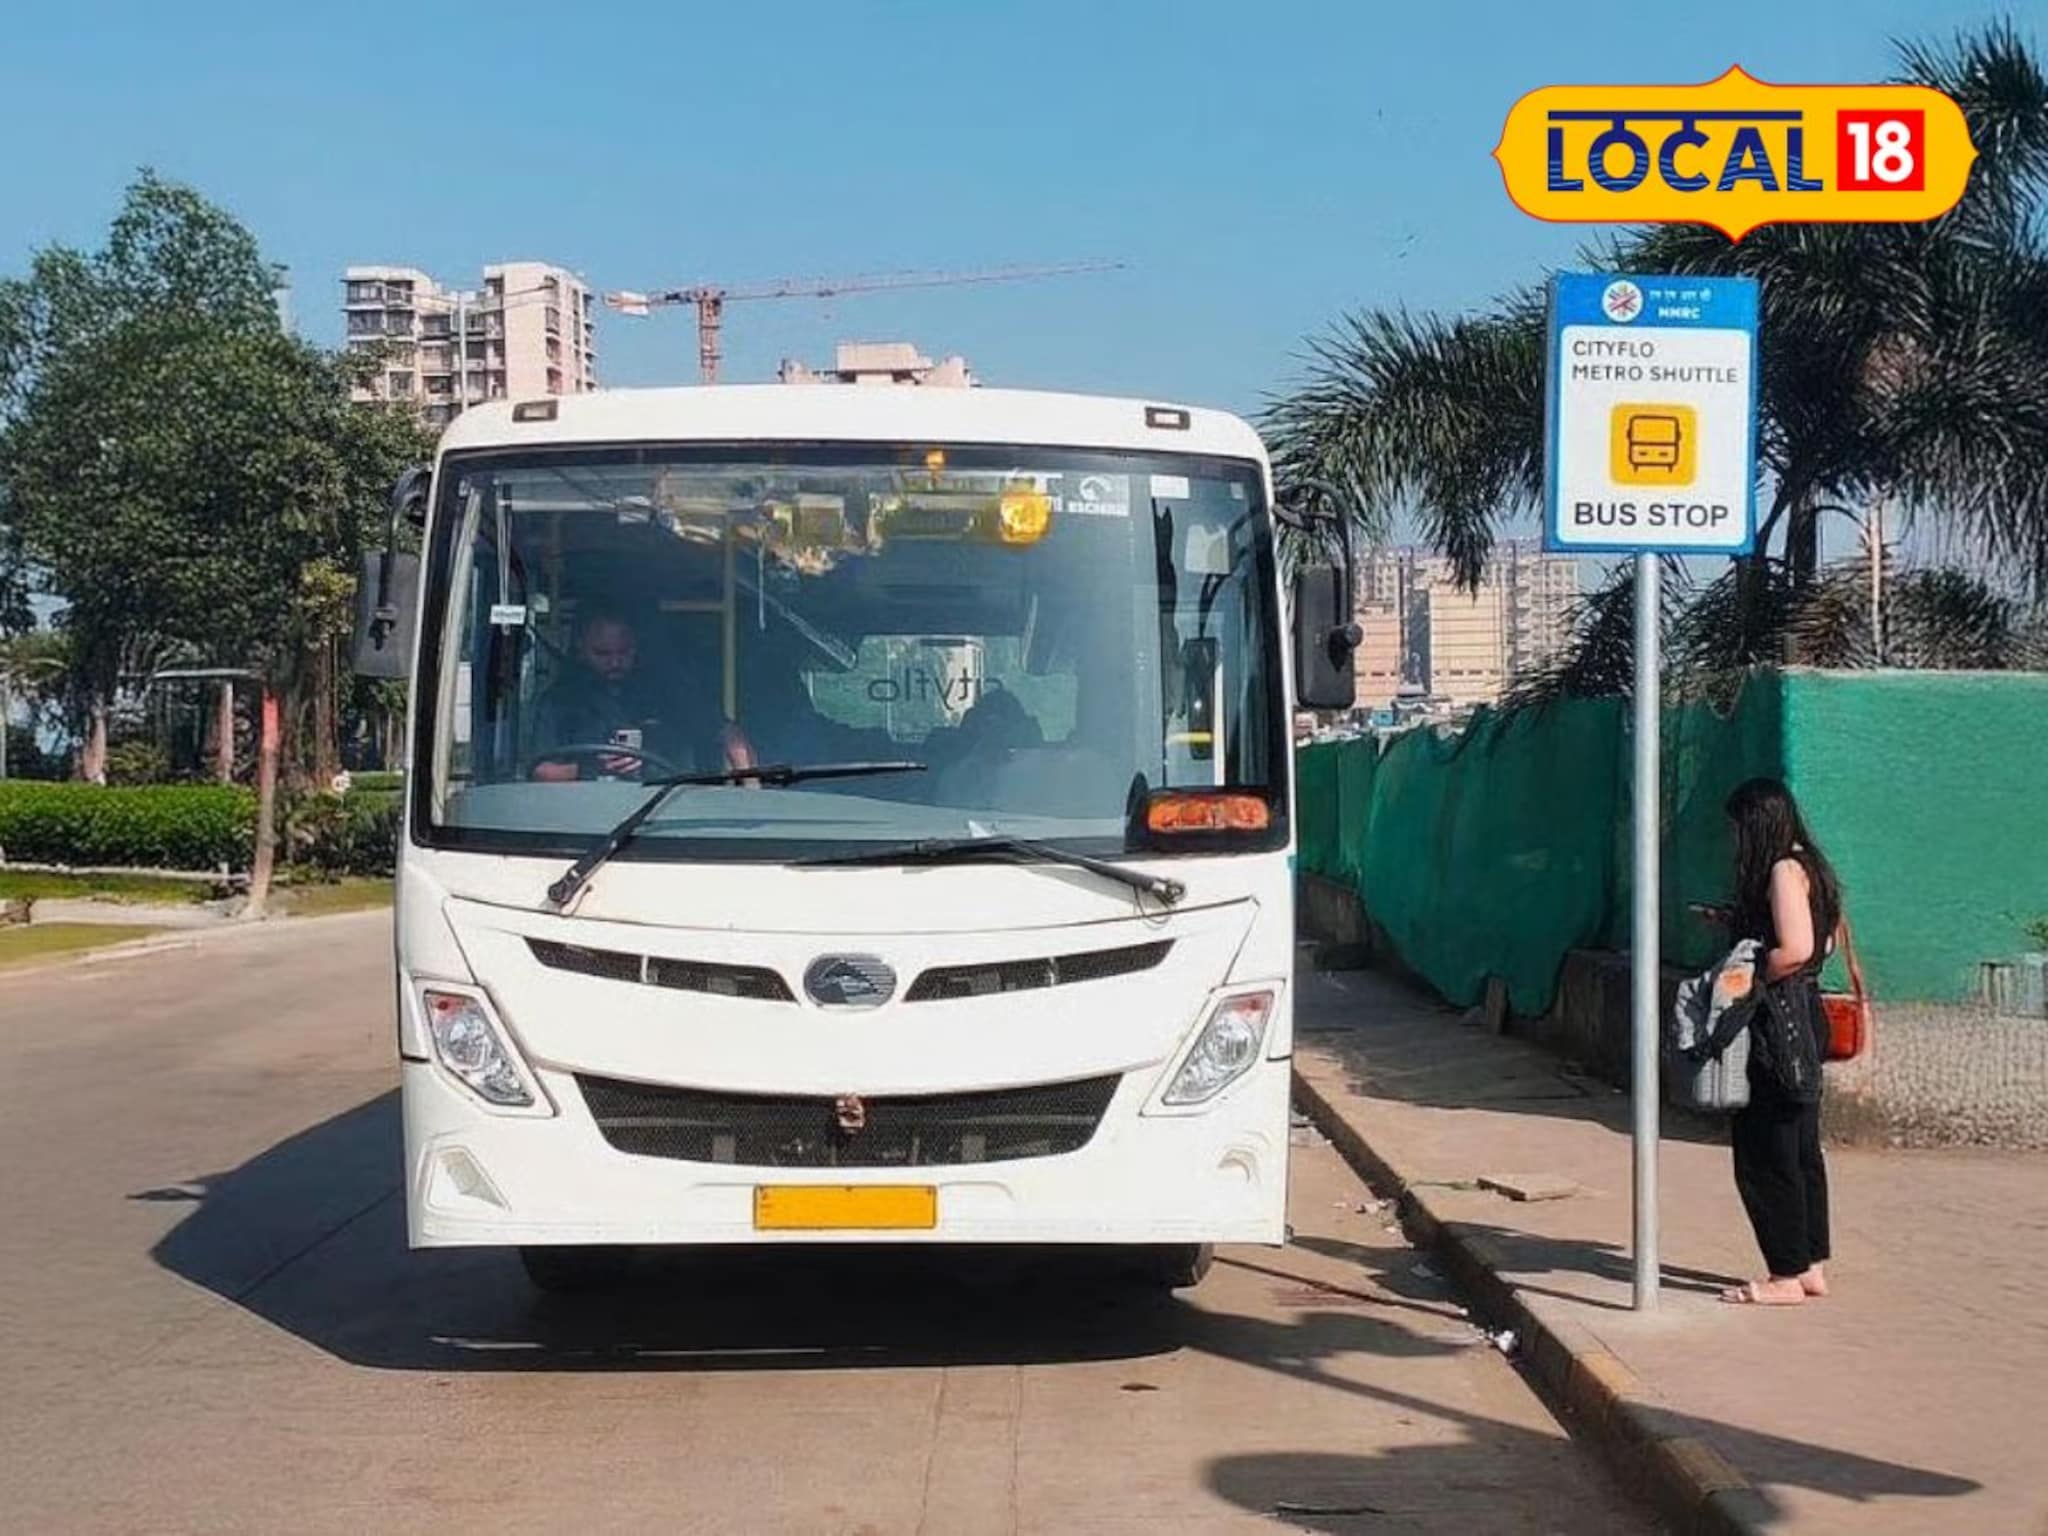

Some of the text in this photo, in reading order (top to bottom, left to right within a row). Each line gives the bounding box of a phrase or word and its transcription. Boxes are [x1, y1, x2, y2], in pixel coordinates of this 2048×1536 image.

[1572, 340, 1655, 358] CITYFLO
[1572, 365, 1738, 383] METRO SHUTTLE
[1574, 502, 1729, 527] BUS STOP
